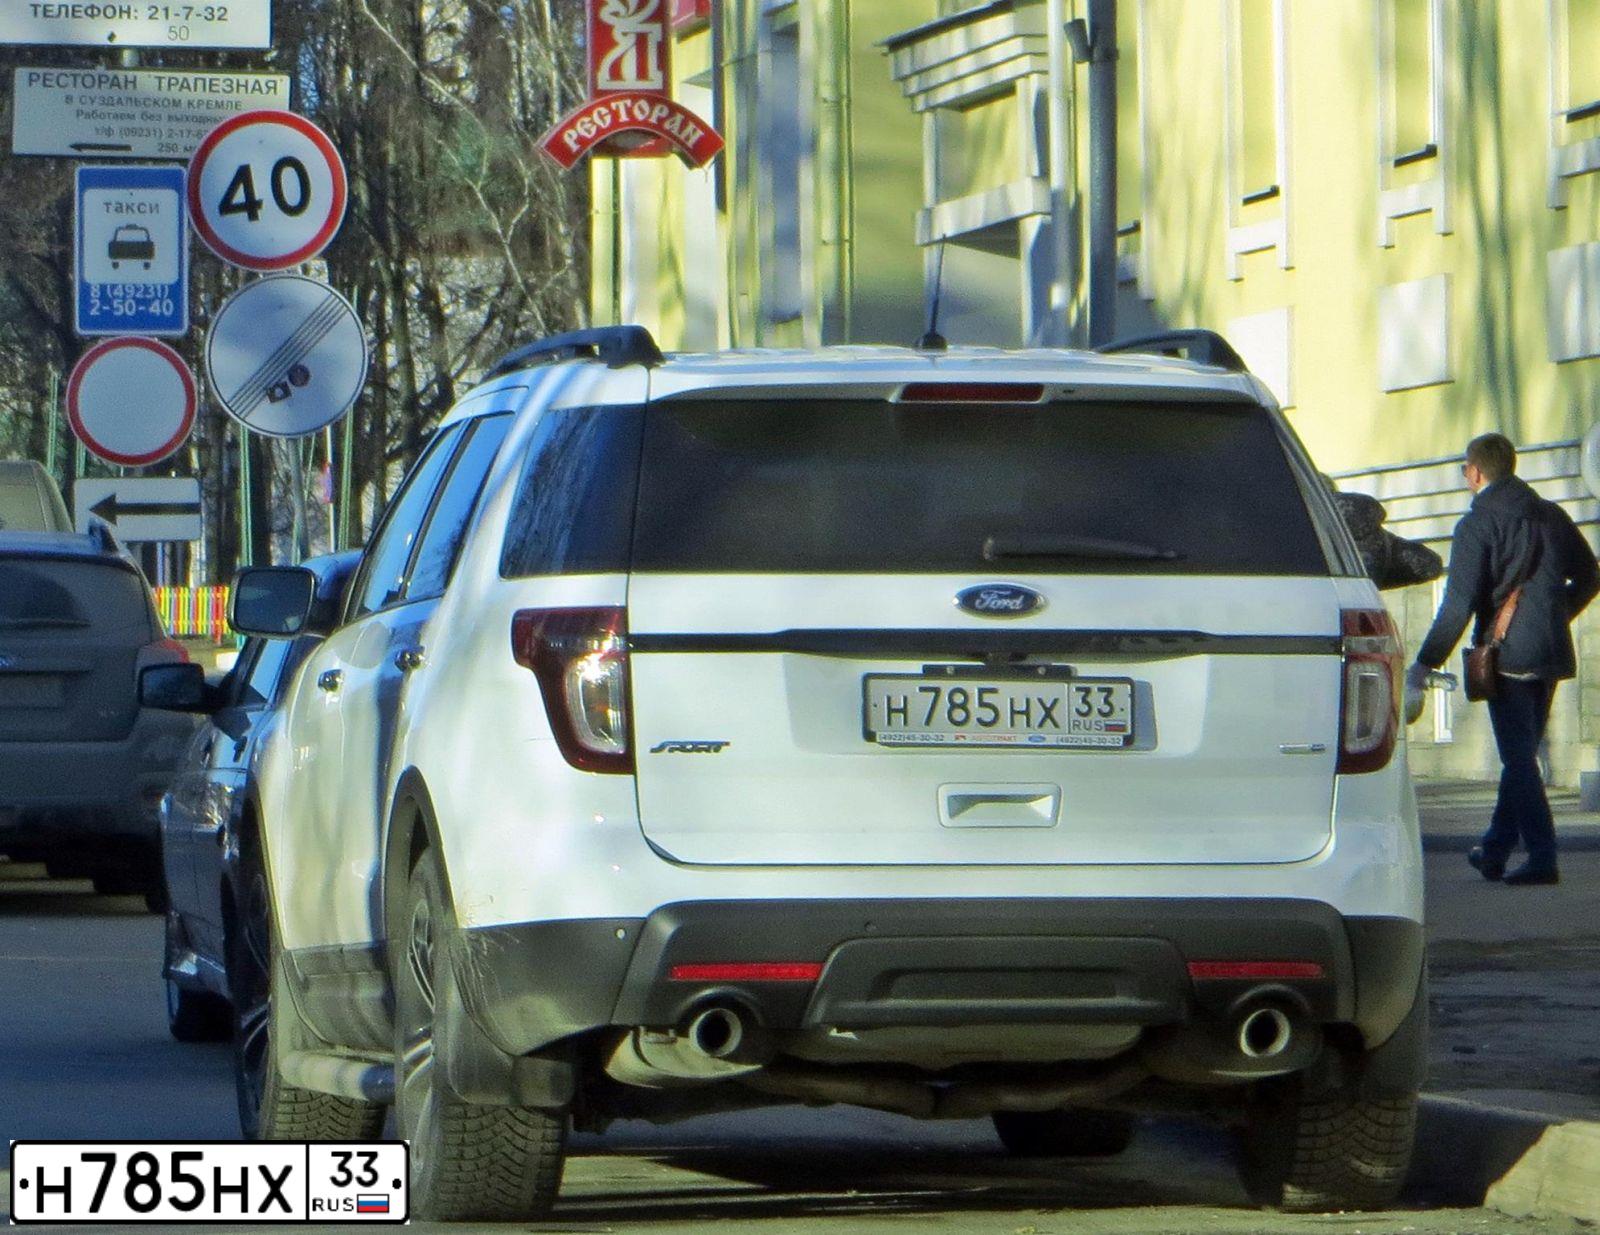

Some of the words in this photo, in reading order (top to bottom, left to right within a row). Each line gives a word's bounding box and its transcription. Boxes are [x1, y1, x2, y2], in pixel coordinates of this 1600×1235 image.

[30, 3, 138, 20] ТЕЛЕФОН:
[148, 6, 228, 22] 21-7-32
[168, 25, 190, 41] 50
[28, 72, 138, 91] РЕСТОРАН
[79, 95, 182, 108] СУЗДАЛЬСКОМ
[187, 99, 242, 111] КРЕМЛЕ
[76, 109, 136, 121] Работаем
[562, 99, 704, 153] РЕСТОРАН
[219, 156, 311, 222] 40
[103, 201, 160, 214] такси
[90, 284, 101, 299] 8
[106, 284, 169, 299] (49231)
[89, 299, 174, 316] 2-50-40
[975, 590, 1024, 609] Ford
[1075, 687, 1114, 717] 33
[1072, 720, 1102, 731] RUS
